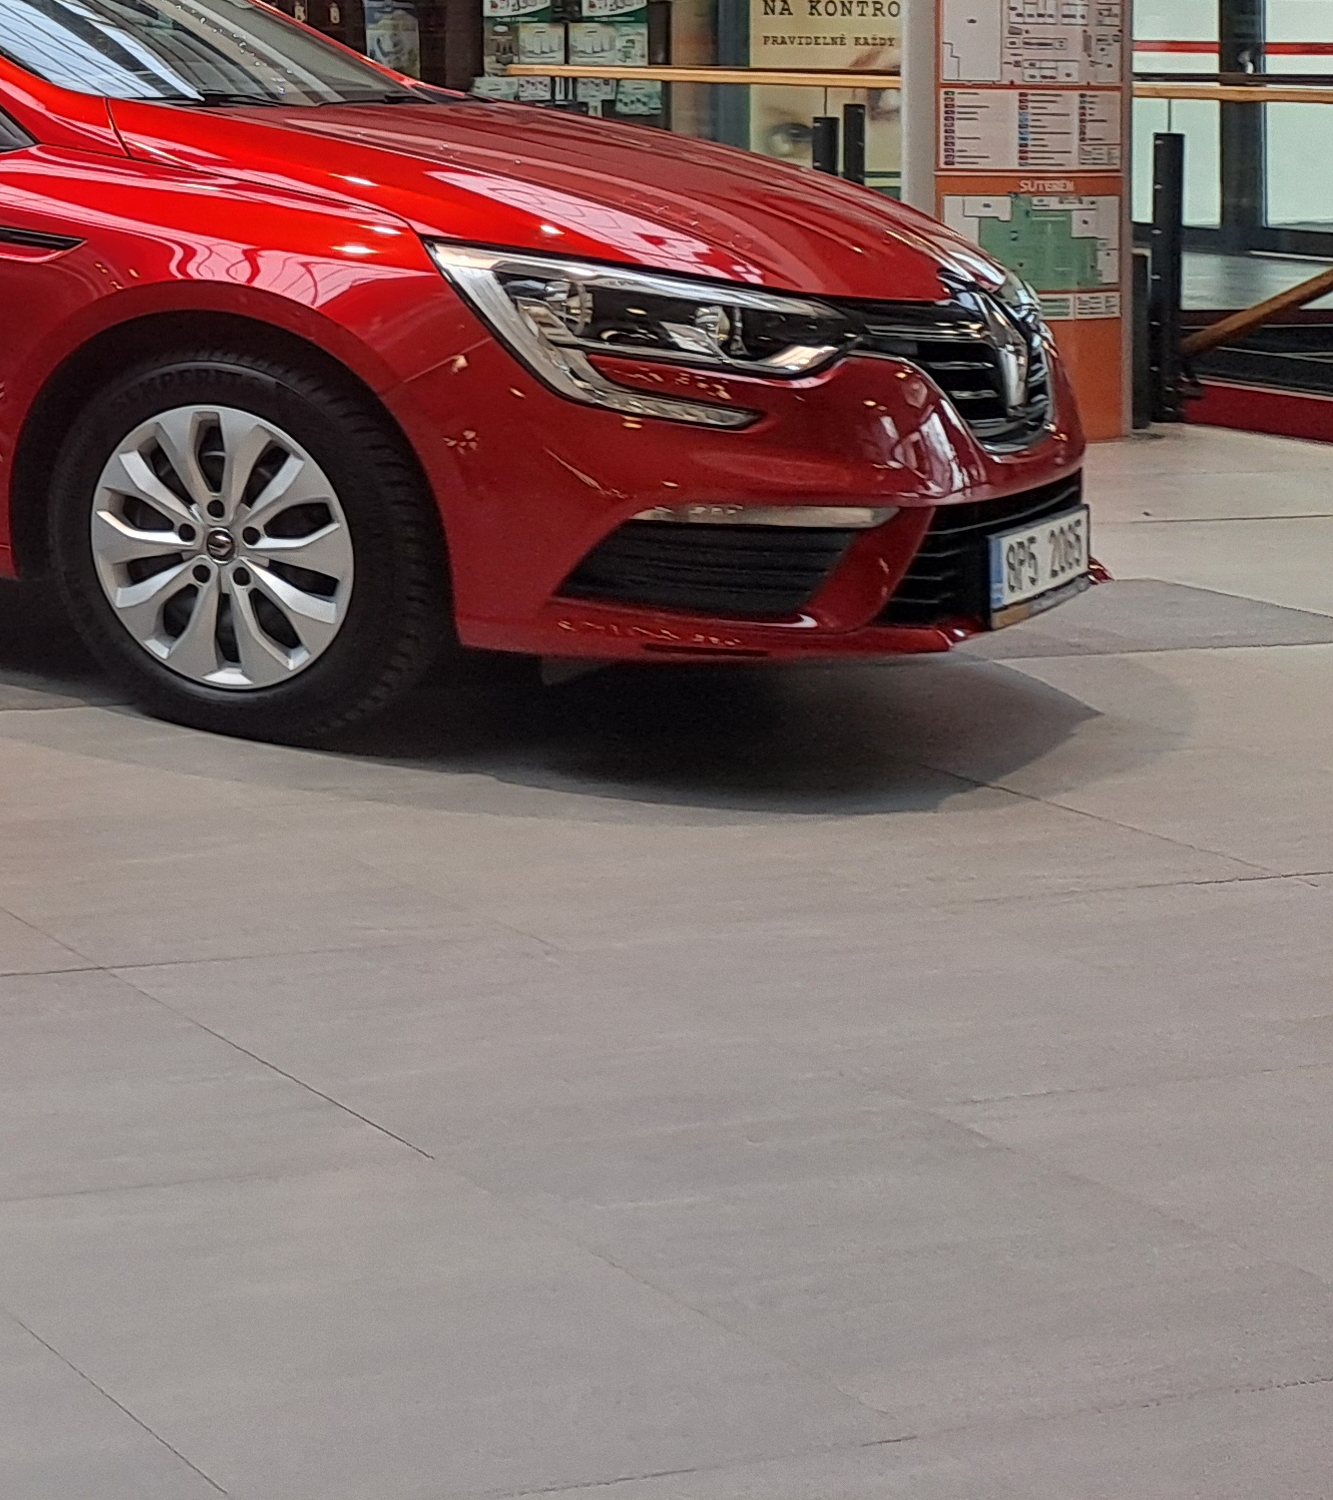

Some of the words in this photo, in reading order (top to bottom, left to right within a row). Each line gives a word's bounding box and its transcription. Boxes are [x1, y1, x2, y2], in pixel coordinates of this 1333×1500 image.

[762, 0, 793, 16] NA
[808, 0, 901, 18] KONTRO
[763, 34, 847, 46] PRAVIDELNĚ
[855, 34, 896, 47] KAŽDÝ
